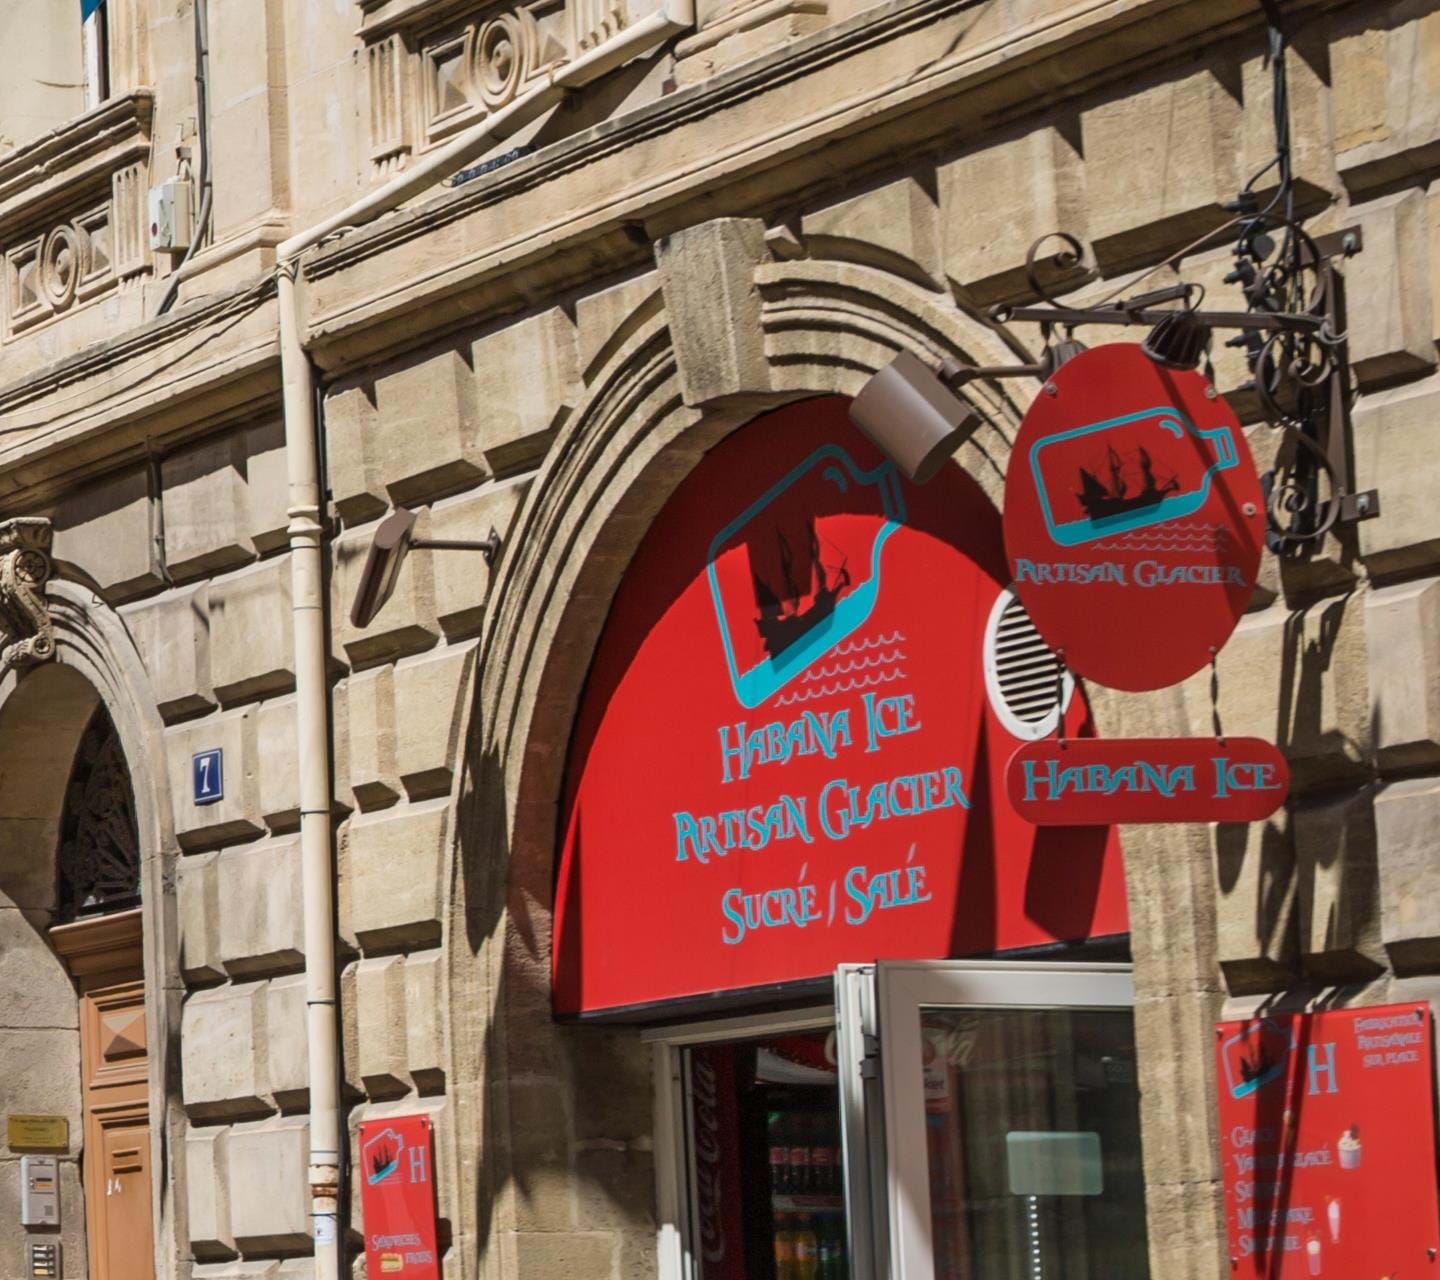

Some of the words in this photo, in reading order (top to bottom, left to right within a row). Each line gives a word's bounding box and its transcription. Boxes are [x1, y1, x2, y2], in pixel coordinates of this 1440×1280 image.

[200, 757, 211, 793] 7
[1307, 1042, 1339, 1096] H
[408, 1146, 427, 1183] H
